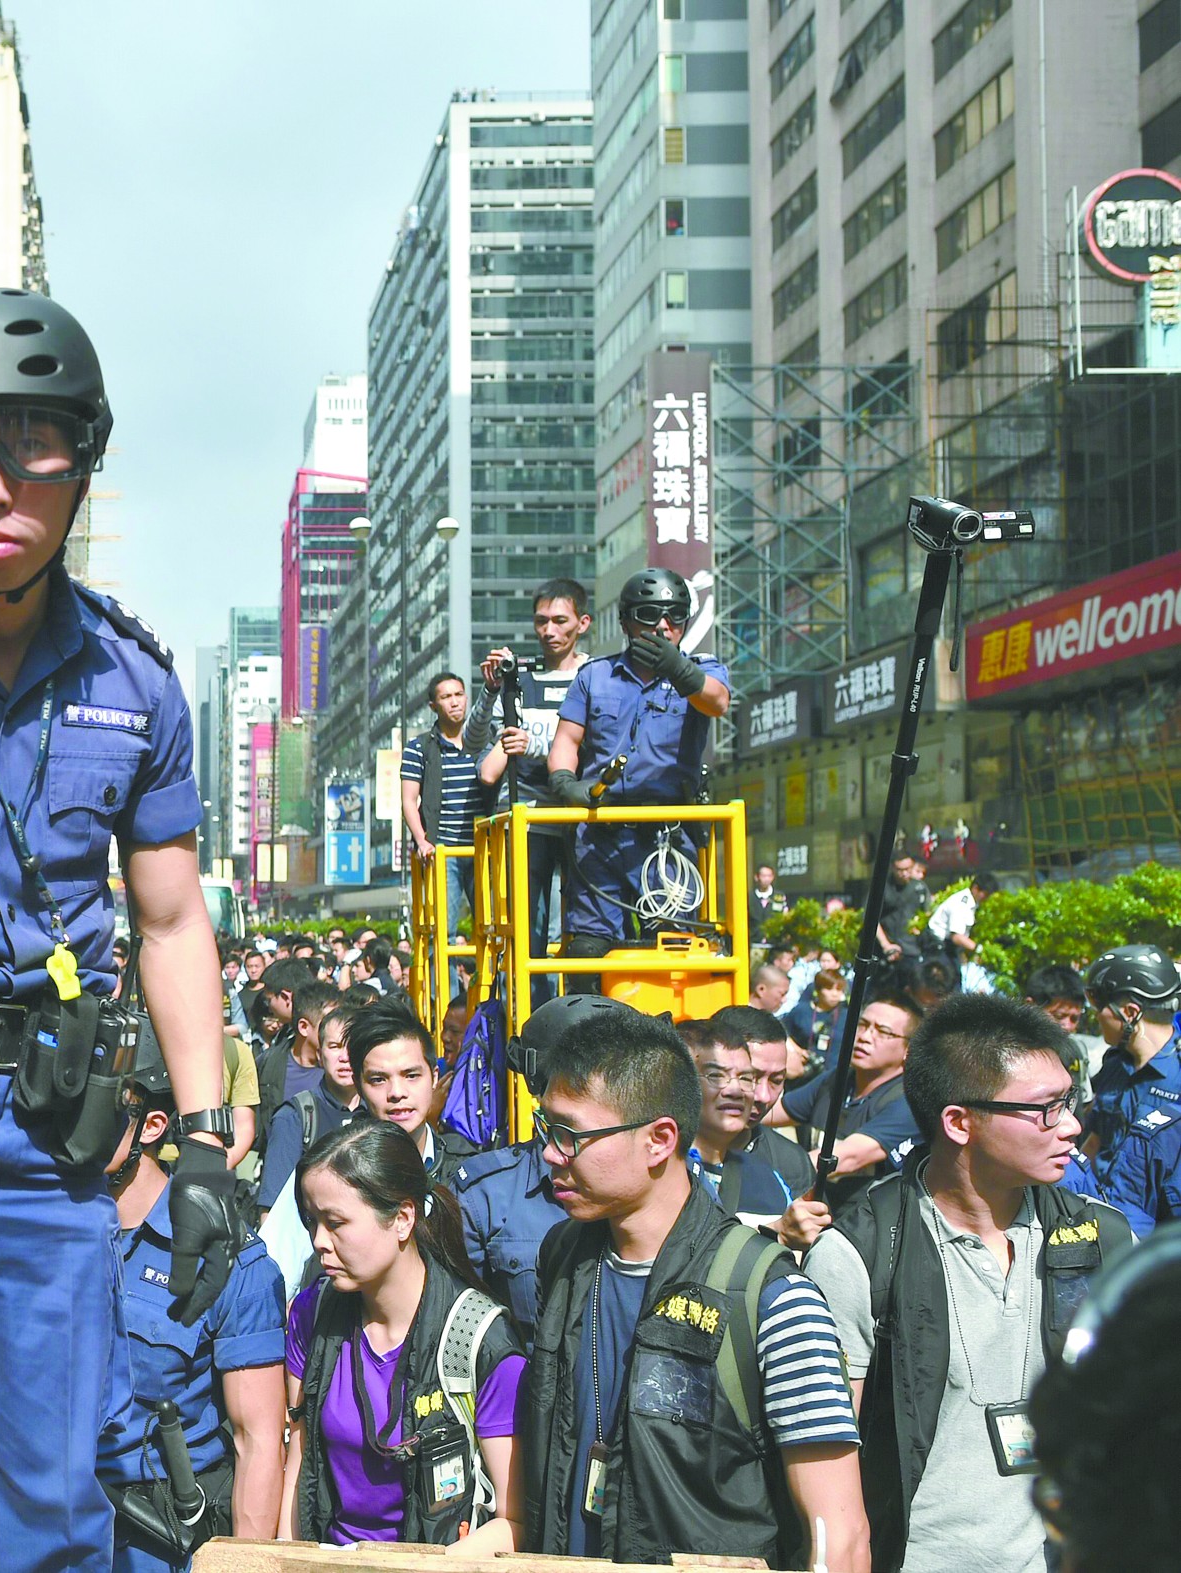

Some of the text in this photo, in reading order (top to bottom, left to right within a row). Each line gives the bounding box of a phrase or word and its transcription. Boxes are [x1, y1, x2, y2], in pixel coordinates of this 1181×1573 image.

[692, 392, 708, 458] LUKFOOK
[977, 619, 1033, 684] 惠康
[83, 708, 133, 727] POLICE
[132, 714, 149, 731] 察
[414, 1389, 444, 1419] 傳媒
